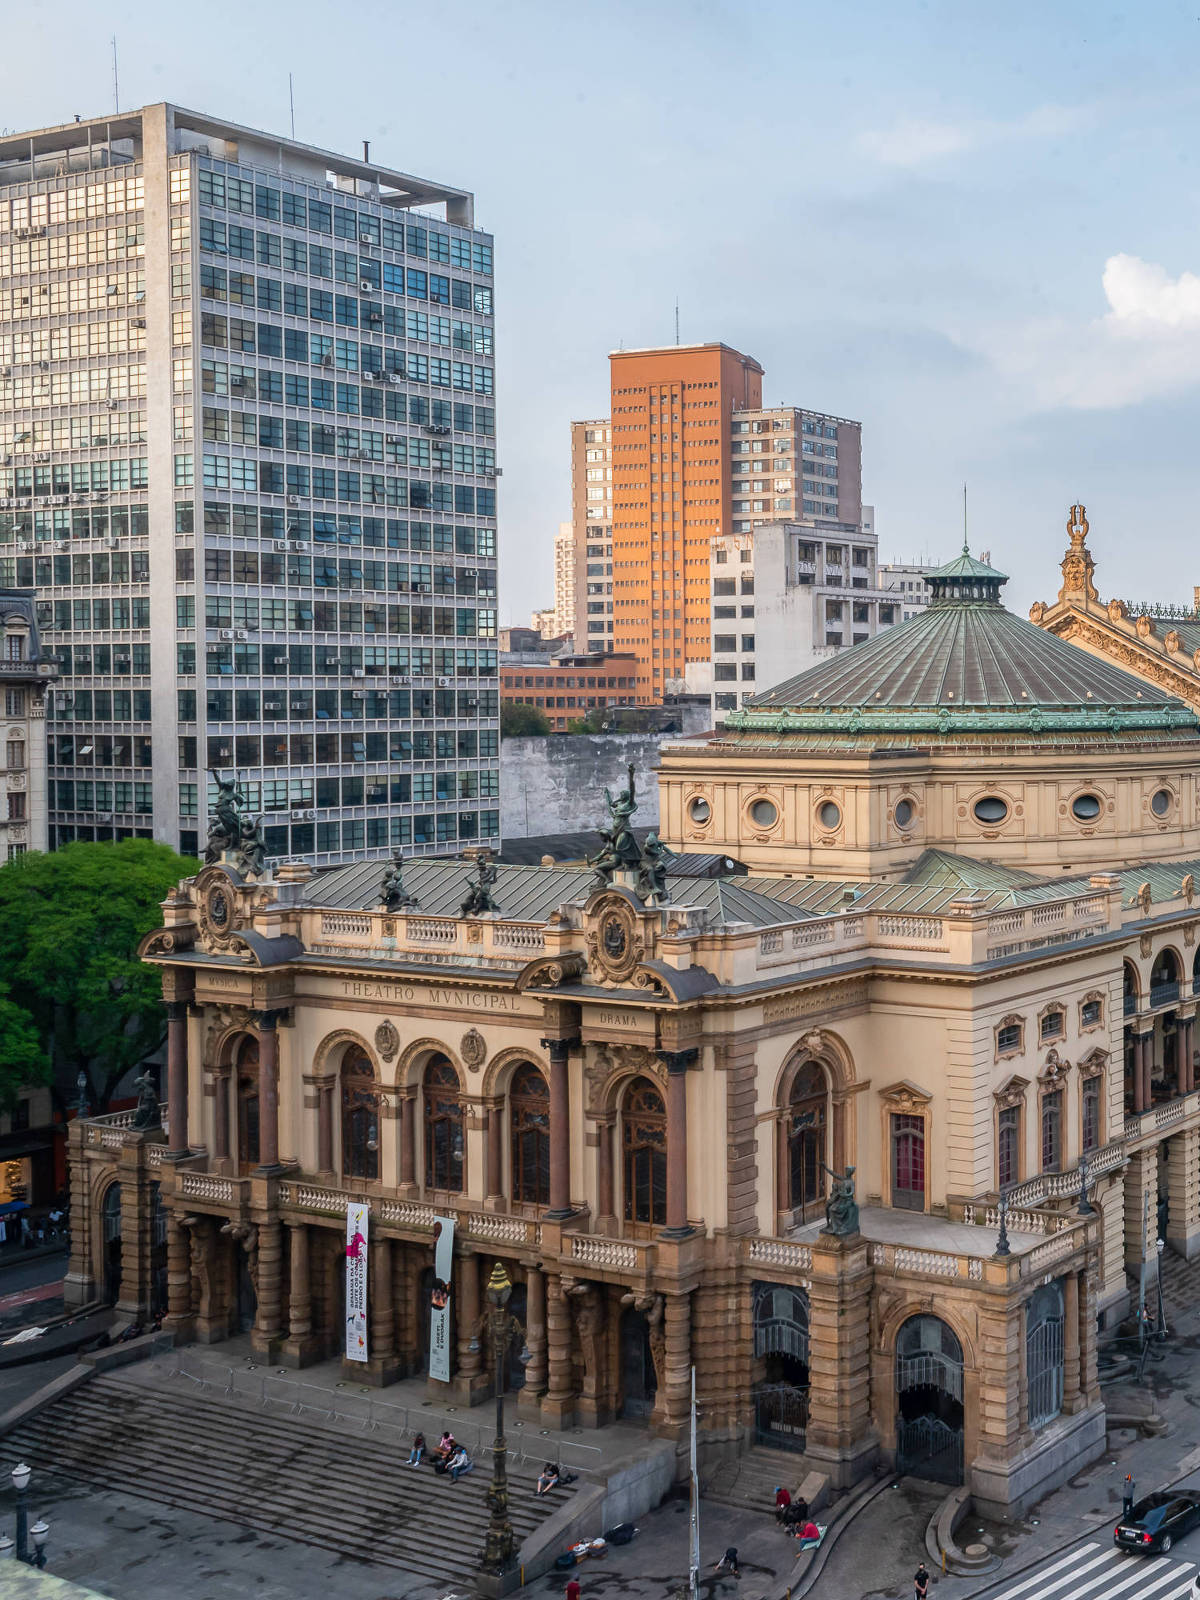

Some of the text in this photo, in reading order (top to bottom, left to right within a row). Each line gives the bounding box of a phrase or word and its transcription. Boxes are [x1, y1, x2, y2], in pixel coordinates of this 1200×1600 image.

[342, 981, 521, 1011] THEATRO MVNICIPAL
[600, 1012, 637, 1027] DRAMA
